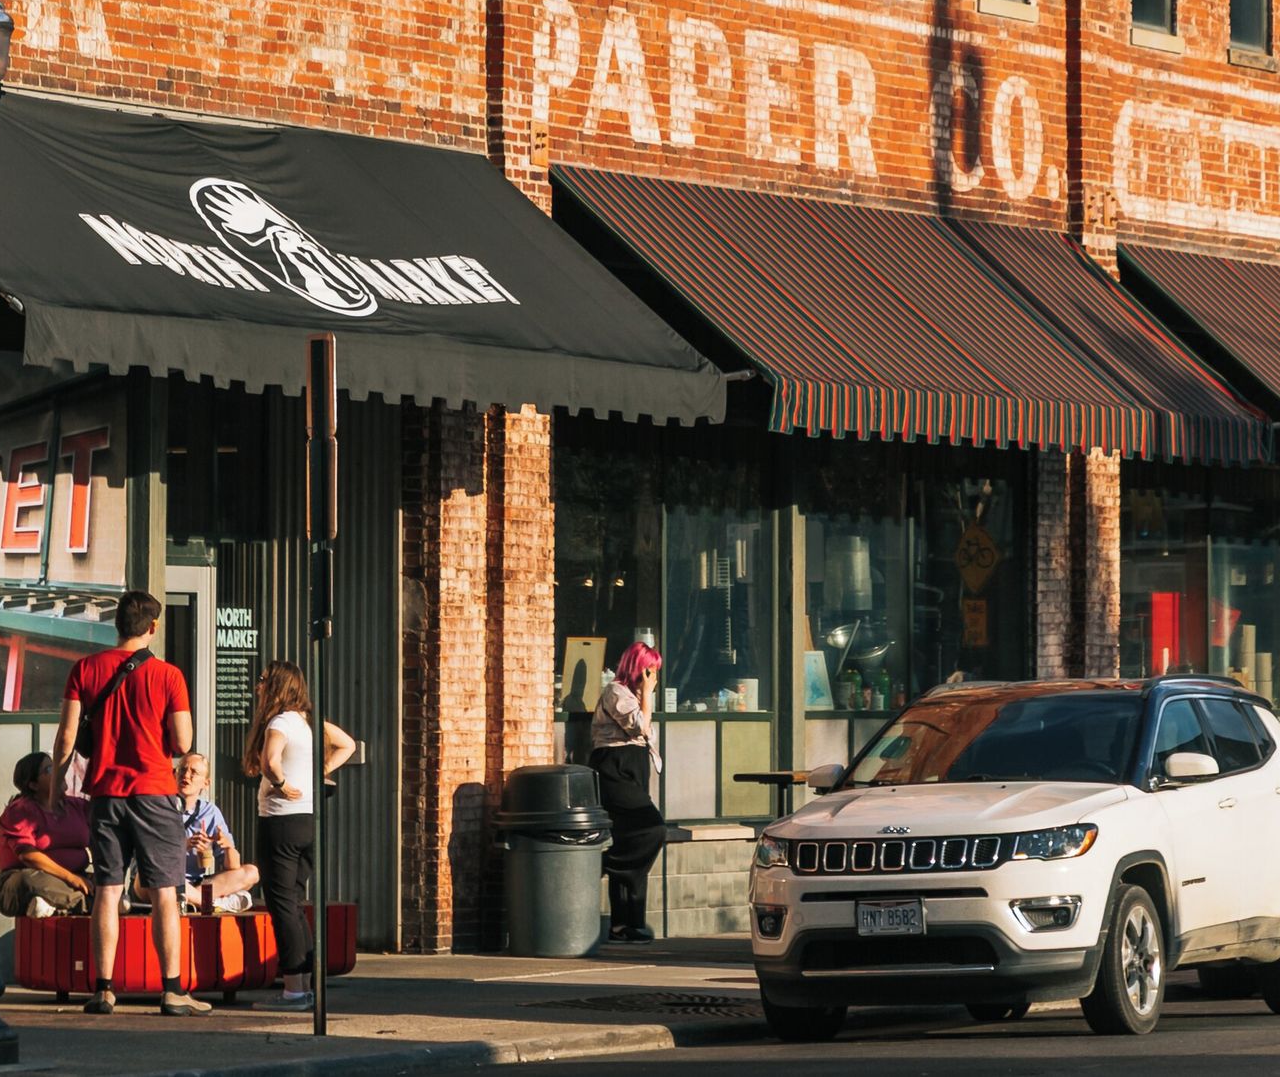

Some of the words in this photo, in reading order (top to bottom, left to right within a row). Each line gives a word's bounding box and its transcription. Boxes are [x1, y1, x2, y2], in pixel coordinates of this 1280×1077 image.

[929, 61, 1061, 202] CO.
[78, 212, 270, 293] NORTH
[336, 253, 521, 305] MARKET
[216, 607, 252, 627] NORTH
[216, 628, 259, 648] MARKET
[862, 910, 883, 927] HNT
[887, 908, 918, 926] 8582
